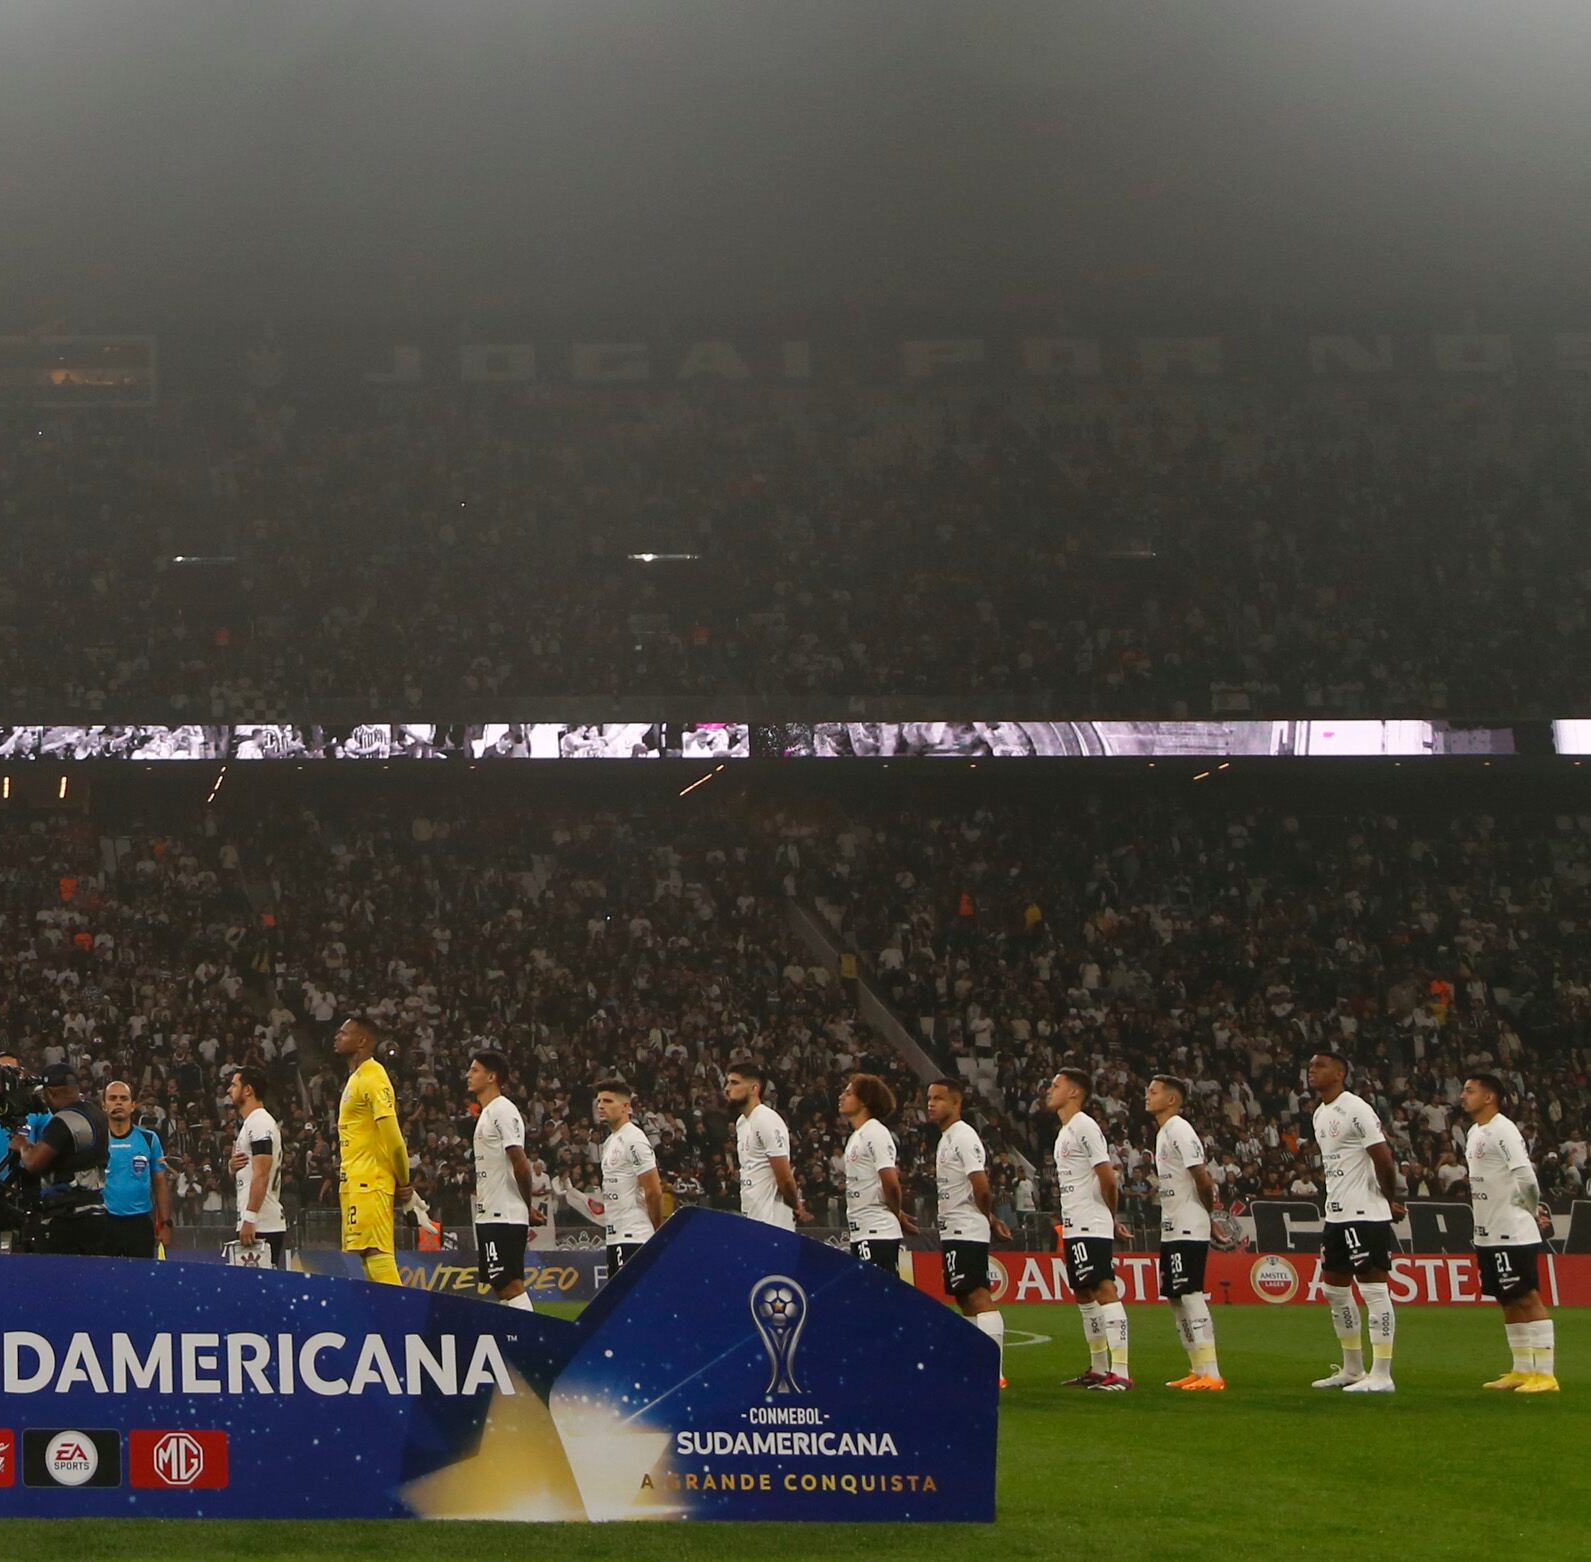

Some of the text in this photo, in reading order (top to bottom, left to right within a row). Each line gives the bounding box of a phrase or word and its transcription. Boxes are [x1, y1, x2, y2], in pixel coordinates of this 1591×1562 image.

[1344, 1227, 1361, 1249] 41
[485, 1241, 498, 1262] 14
[616, 1245, 624, 1266] 2
[945, 1250, 956, 1272] 27
[1072, 1242, 1088, 1264] 30
[1495, 1252, 1512, 1272] 21
[1170, 1252, 1182, 1274] 28
[56, 1443, 88, 1460] EA
[676, 1431, 898, 1456] SUDAMERICANA
[54, 1462, 90, 1471] SPORTS
[158, 1437, 199, 1480] MG
[641, 1473, 937, 1494] A GRANDE CONQUISTA
